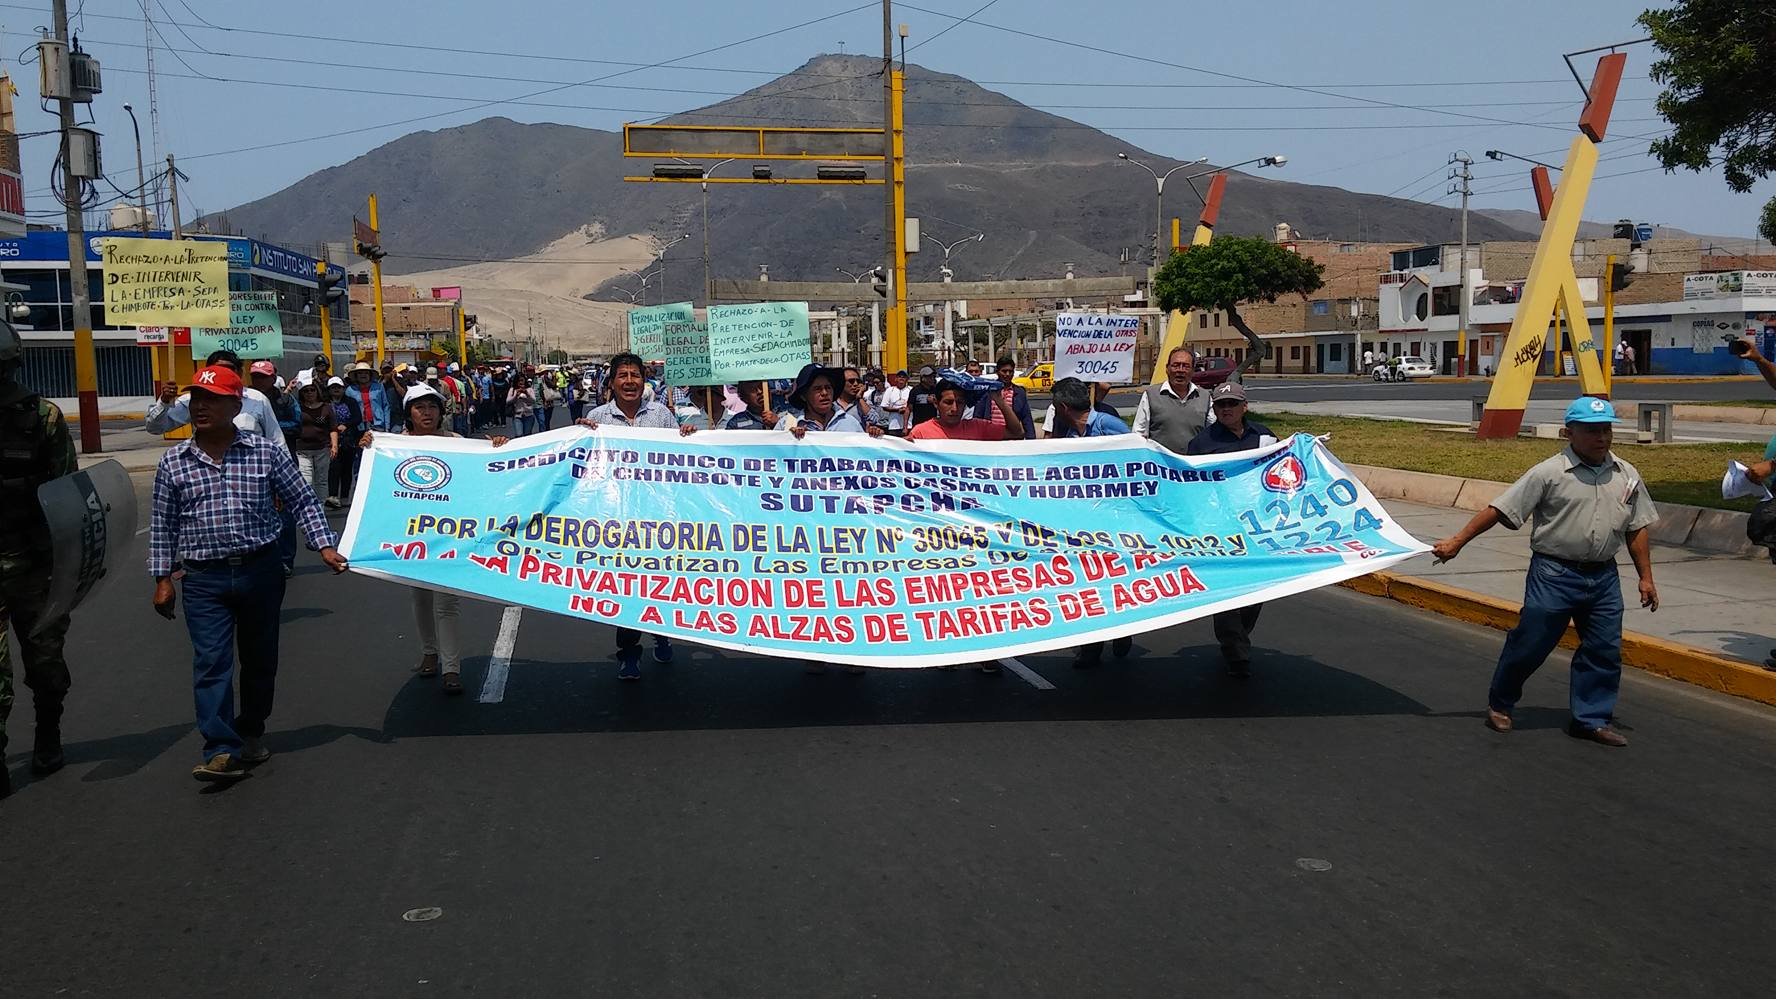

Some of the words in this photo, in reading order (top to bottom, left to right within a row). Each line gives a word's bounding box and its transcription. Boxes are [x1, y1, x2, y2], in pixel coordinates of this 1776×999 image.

[261, 245, 297, 273] INSTITUTO
[298, 259, 312, 278] SAN
[136, 270, 205, 284] INTERVENIR
[111, 289, 127, 303] LA
[134, 286, 185, 300] EMPRESA
[111, 301, 156, 313] CHIMBOTE
[180, 300, 191, 310] LA
[195, 299, 226, 309] OTASS
[232, 303, 242, 311] EN
[244, 303, 278, 312] CONTRA
[236, 315, 255, 324] LEY
[711, 321, 772, 333] PRETENCION
[779, 319, 795, 328] DE
[1058, 317, 1072, 326] NO
[1076, 317, 1084, 326] A
[1088, 316, 1103, 326] LA
[1106, 318, 1138, 328] INTER
[199, 325, 275, 337] PRIVATIZADORA
[633, 323, 653, 335] LEGAL
[1057, 329, 1092, 339] VENCION
[1115, 329, 1137, 338] OTASS
[218, 338, 259, 352] 30045
[666, 336, 696, 346] LEGAL
[713, 331, 773, 346] INTERVENIR
[1065, 343, 1098, 355] ABAJO
[1099, 343, 1111, 353] LA
[1113, 342, 1135, 352] LEY
[780, 351, 811, 363] OTASS
[1075, 360, 1120, 374] 30045
[666, 369, 685, 380] EPS
[487, 446, 639, 473] SINDICATO
[648, 450, 735, 470] UNICO
[743, 457, 777, 473] DE
[1044, 463, 1120, 482] AGUA
[1126, 461, 1227, 483] POTABLE
[612, 467, 762, 488] CHIMBOTE
[768, 476, 786, 489] Y
[791, 474, 897, 491] ANEXOS
[903, 476, 1000, 496] CASMA
[1005, 484, 1022, 498] Y
[1029, 481, 1159, 499] HUARMEY
[393, 490, 450, 501] SUTAPCHA
[760, 490, 985, 515] SUTAPCHA
[1240, 478, 1358, 535] 1240
[487, 515, 518, 537] LA
[524, 512, 724, 551] DEROGATORIA
[733, 523, 768, 552] DE
[775, 525, 811, 553] LA
[817, 526, 868, 554] LEY
[913, 524, 989, 553] 30045
[1021, 520, 1058, 547] DE
[1118, 532, 1157, 549] DL
[1160, 533, 1223, 550] 1012
[1257, 507, 1383, 551] 1224
[576, 550, 740, 574] Privatizan
[753, 555, 808, 574] Las
[820, 554, 978, 575] Empresas
[519, 554, 773, 608] PRIVATIZACION
[784, 579, 826, 608] DE
[834, 578, 896, 608] LAS
[904, 555, 1075, 605] EMPRESAS
[1079, 553, 1127, 581] DE
[570, 595, 621, 618] NO
[640, 606, 663, 625] A
[674, 609, 738, 635] LAS
[748, 614, 855, 643] ALZAS
[863, 612, 910, 643] DE
[915, 596, 1053, 641] TARIFAS
[1057, 588, 1105, 622] DE
[1112, 566, 1208, 612] AGUA
